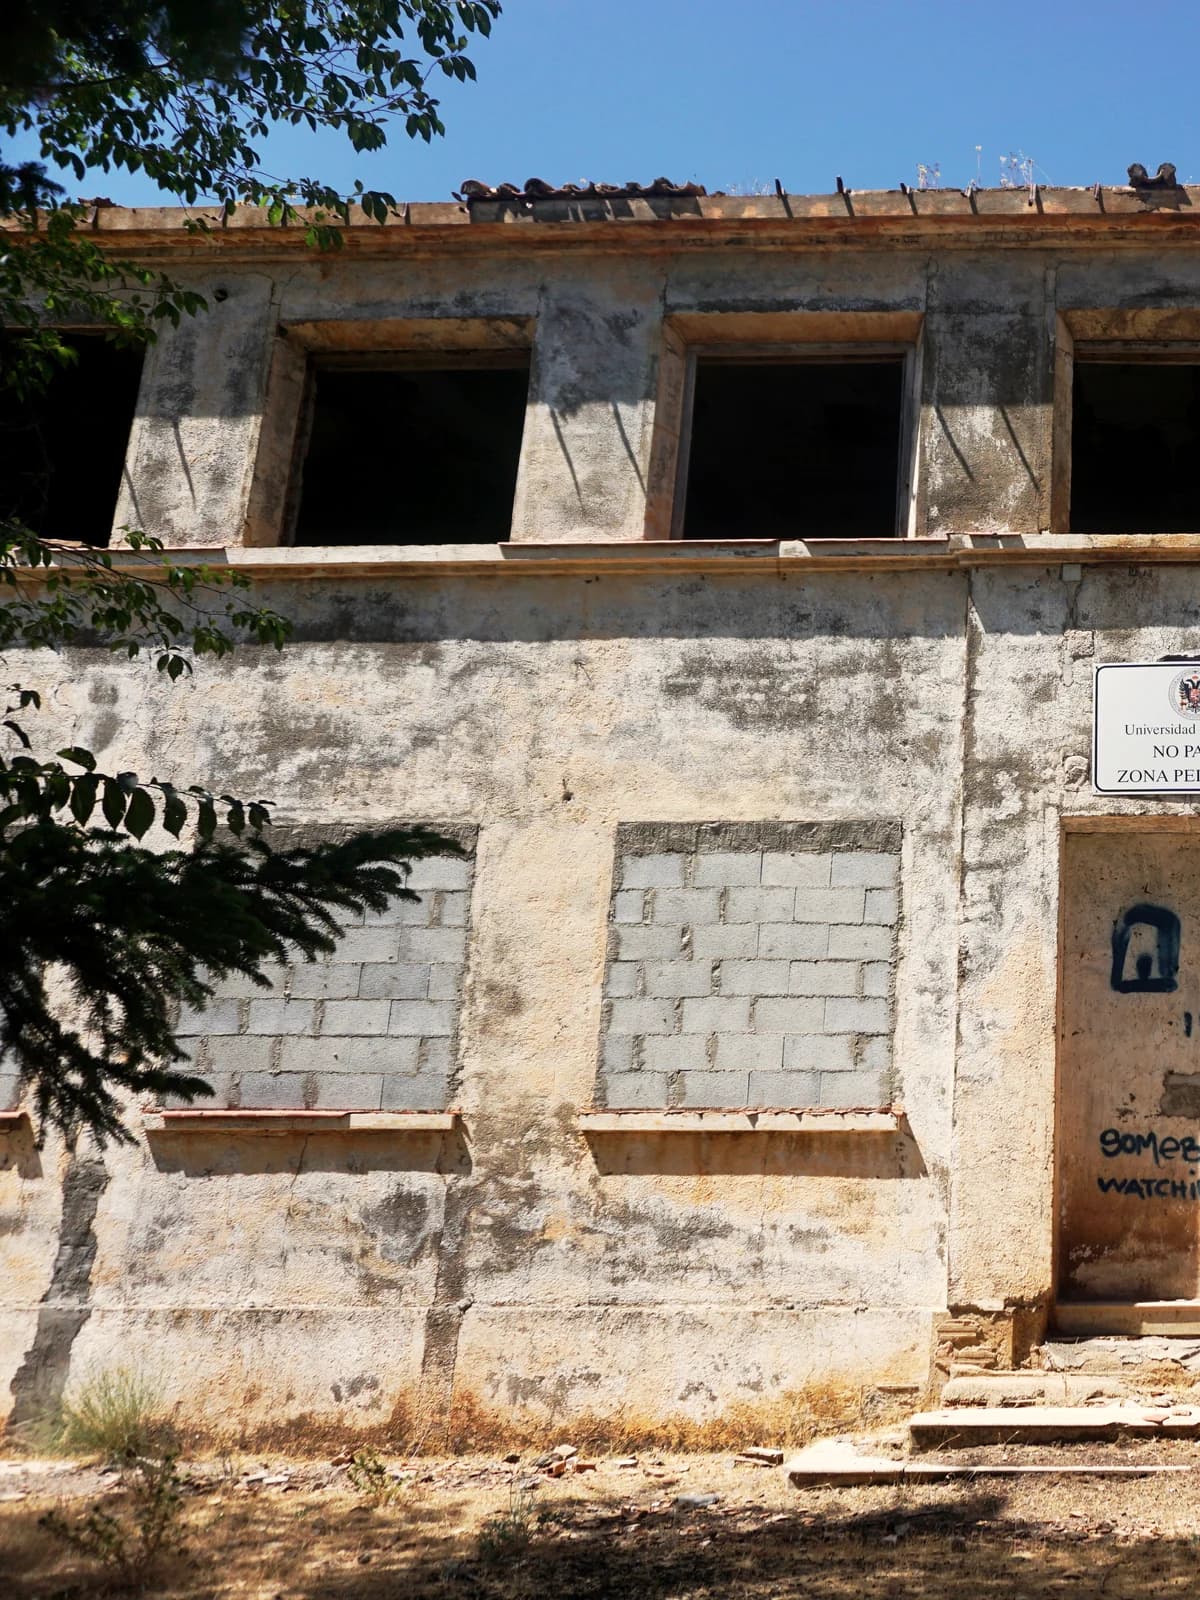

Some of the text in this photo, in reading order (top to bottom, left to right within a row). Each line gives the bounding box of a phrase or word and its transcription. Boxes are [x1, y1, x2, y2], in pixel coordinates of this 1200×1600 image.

[1124, 723, 1196, 736] Universidad
[1152, 744, 1179, 759] NO
[1117, 769, 1169, 783] ZONA
